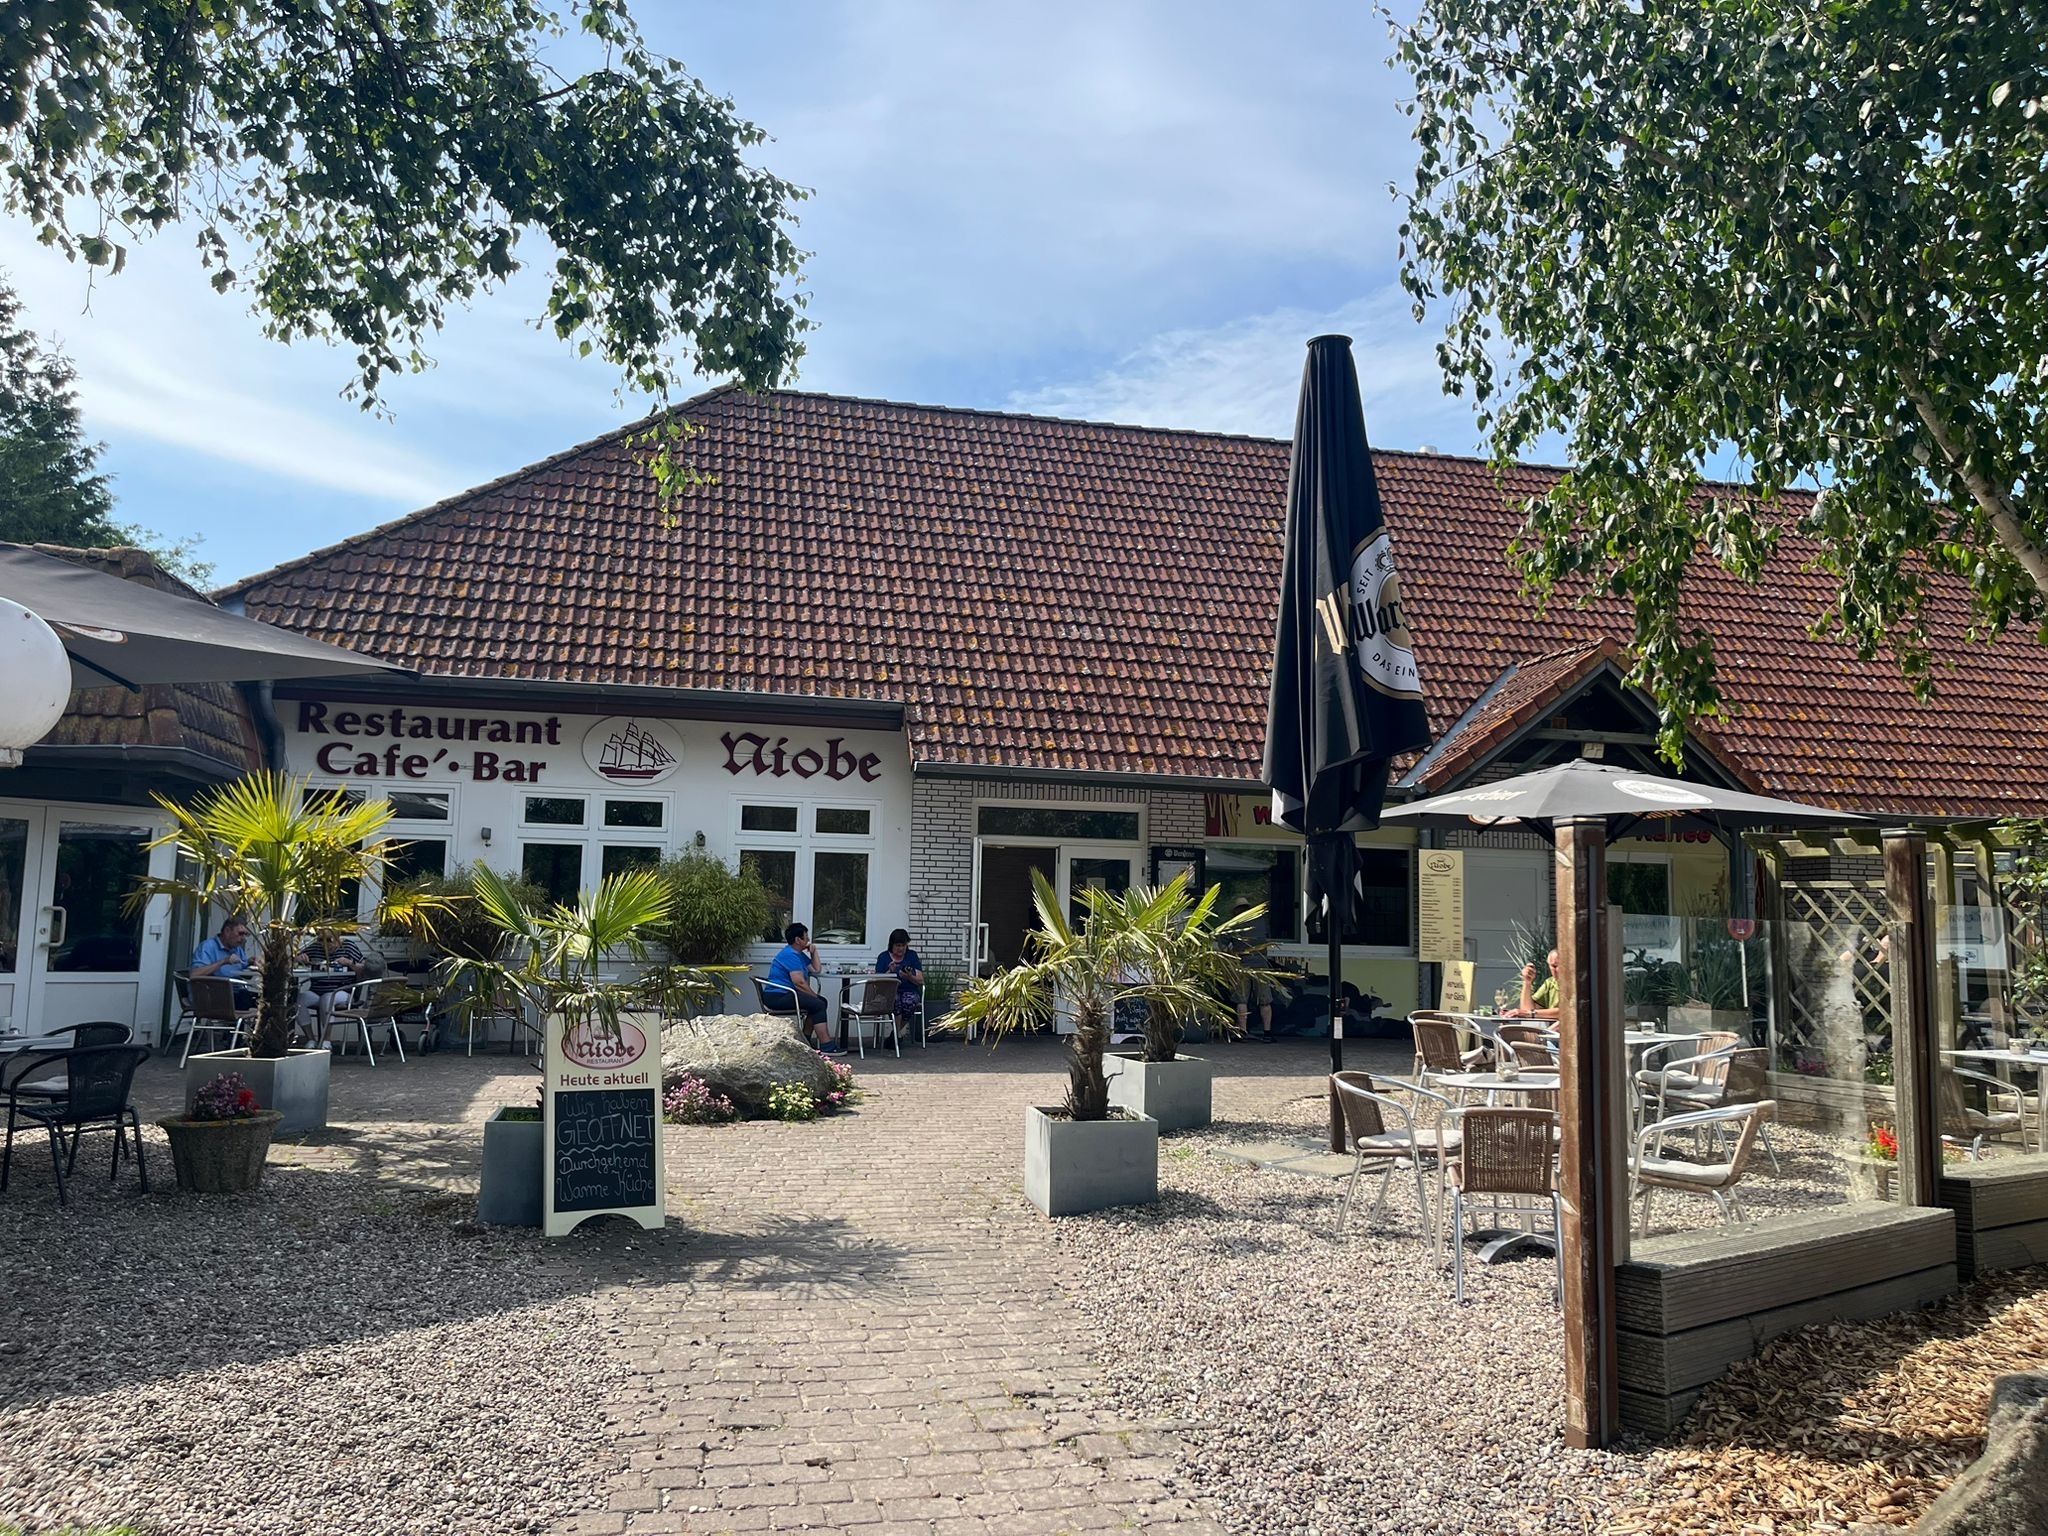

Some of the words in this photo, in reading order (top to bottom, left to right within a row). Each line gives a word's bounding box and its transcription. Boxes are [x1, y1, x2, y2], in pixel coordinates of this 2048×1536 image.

[1357, 568, 1374, 594] SEIT
[1373, 653, 1391, 671] DAS
[297, 701, 561, 745] Restaurant
[473, 752, 546, 782] Bar
[720, 731, 882, 783] Niobe
[577, 1041, 636, 1058] Niobe
[560, 1074, 600, 1086] Heute
[603, 1072, 649, 1085] aktuell
[562, 1093, 594, 1117] Wir
[601, 1092, 651, 1113] haben
[560, 1150, 648, 1174] Durchgehend
[611, 1169, 654, 1204] Küche
